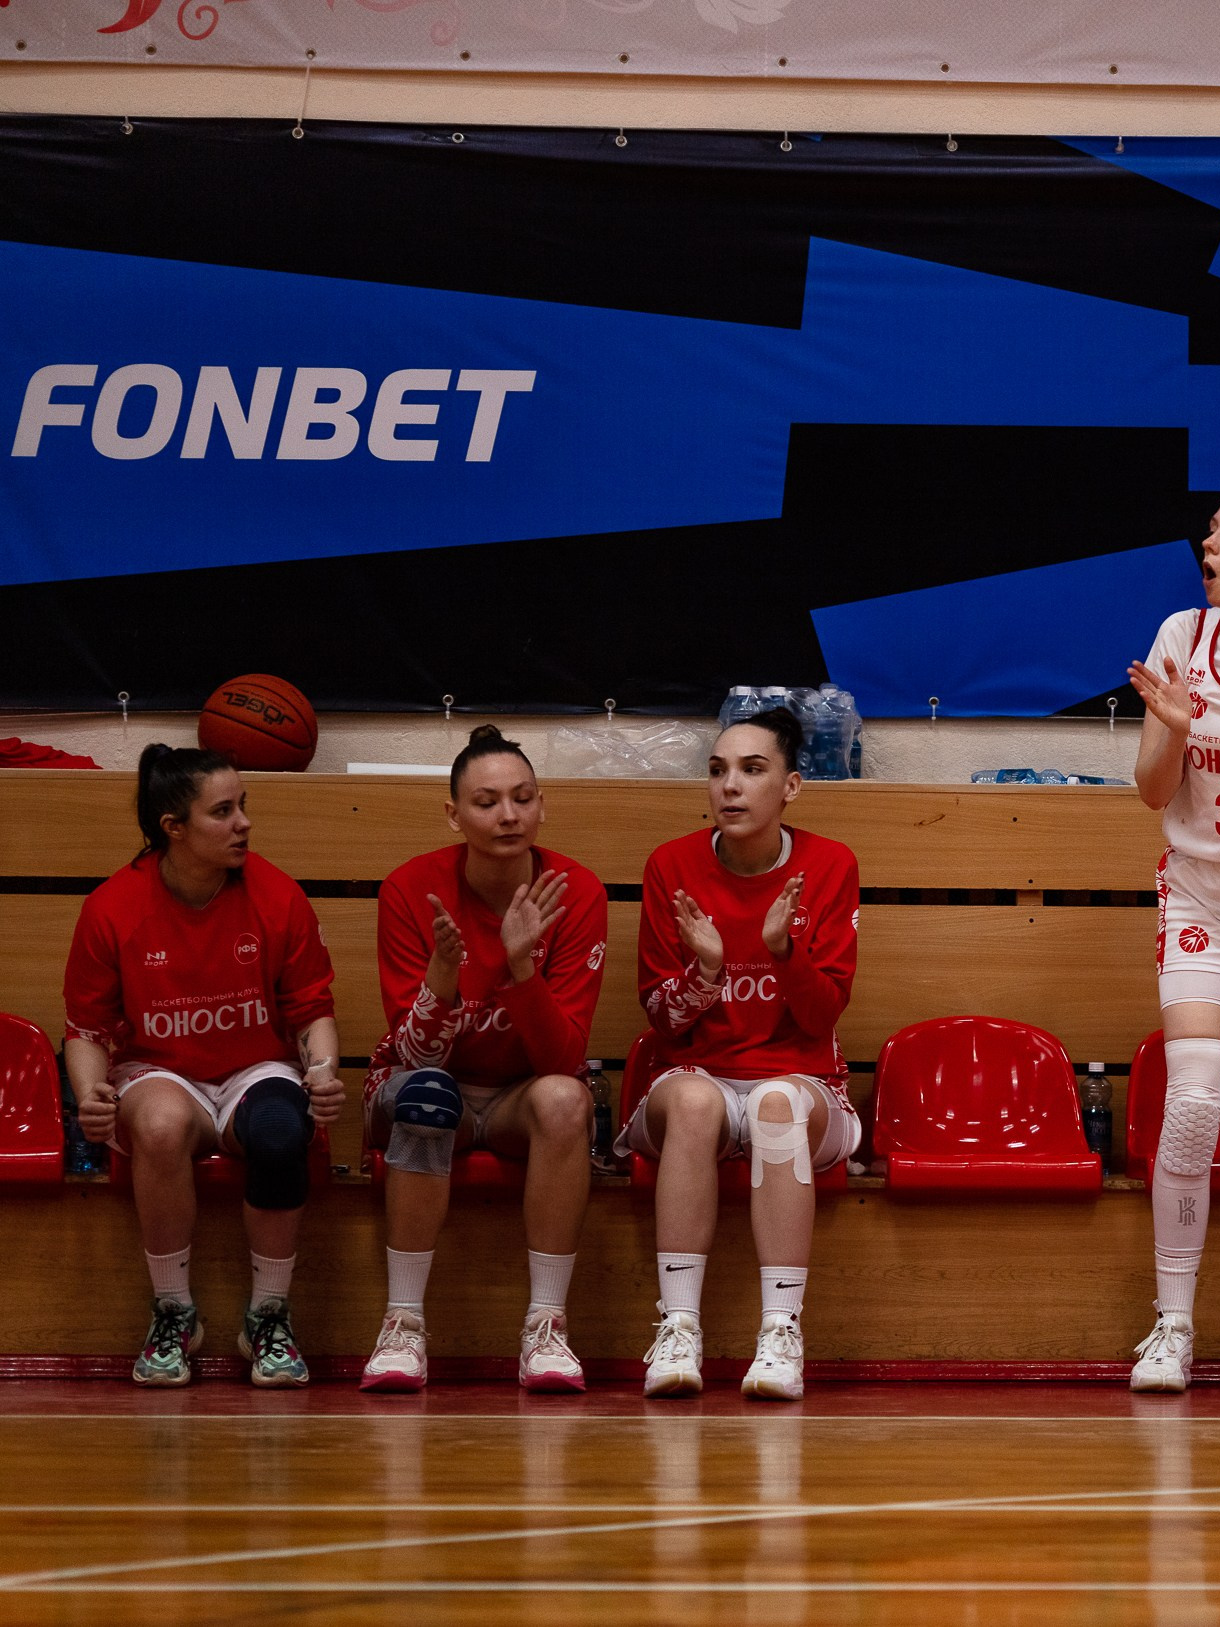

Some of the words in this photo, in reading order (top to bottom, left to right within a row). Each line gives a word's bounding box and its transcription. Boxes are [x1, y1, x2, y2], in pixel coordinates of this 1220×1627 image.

[11, 363, 537, 462] FONBET
[151, 992, 235, 1007] БАСКЕТБОЛЬНЫЙ
[237, 987, 260, 998] КЛУБ
[143, 999, 269, 1038] ЮНОСТЬ
